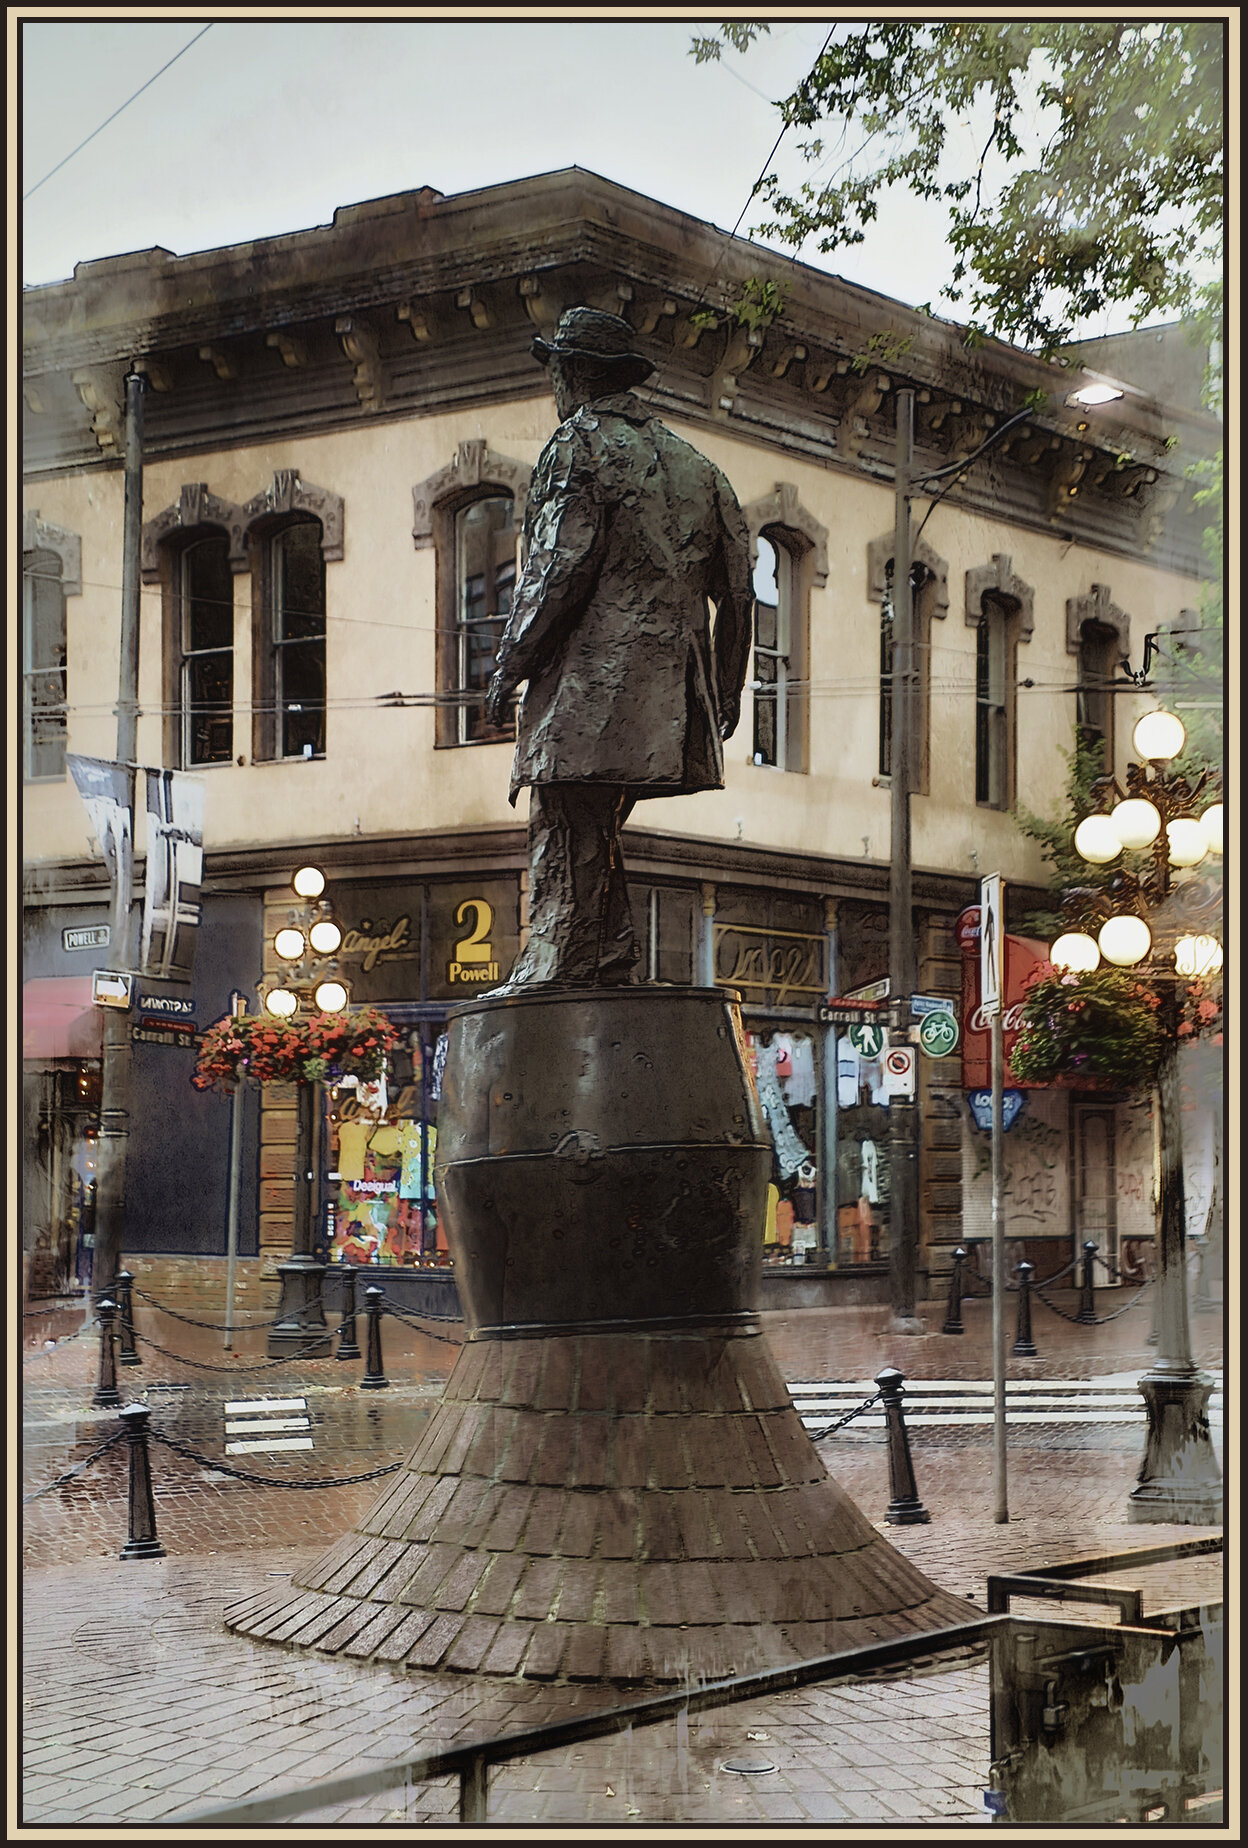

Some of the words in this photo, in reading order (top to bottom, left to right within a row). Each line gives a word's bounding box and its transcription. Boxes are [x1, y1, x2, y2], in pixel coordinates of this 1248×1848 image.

[456, 900, 492, 962] 2
[450, 963, 499, 983] Powell
[820, 1007, 859, 1023] Carrall
[864, 1011, 876, 1024] St
[353, 1179, 397, 1194] Desigual
